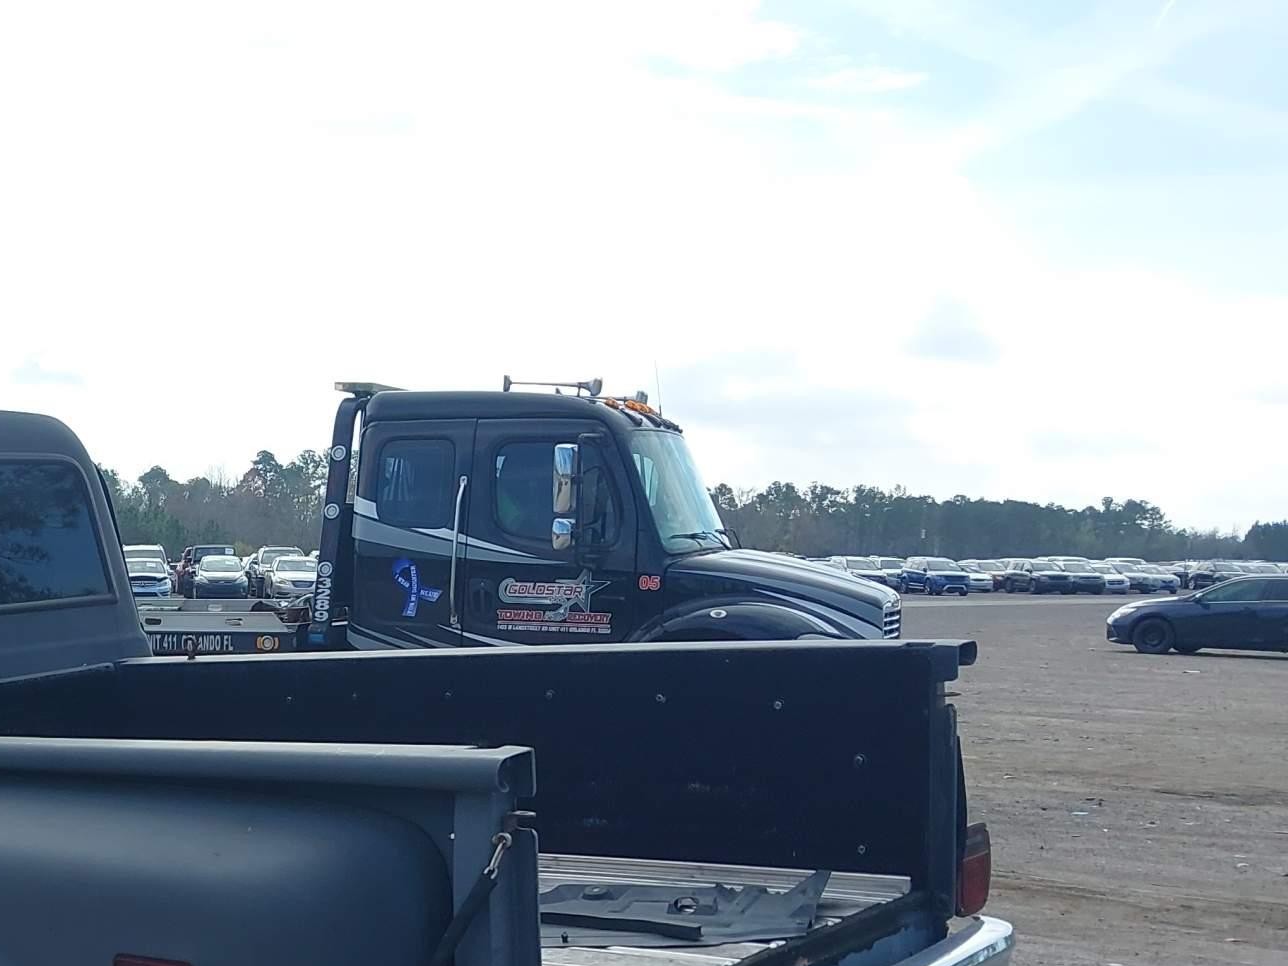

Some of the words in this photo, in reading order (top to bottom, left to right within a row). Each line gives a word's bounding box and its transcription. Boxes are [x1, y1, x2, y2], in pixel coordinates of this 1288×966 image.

[639, 575, 661, 590] 05
[314, 577, 332, 622] 3289
[497, 610, 543, 620] TOWING
[163, 634, 177, 650] 411
[223, 634, 234, 650] FL
